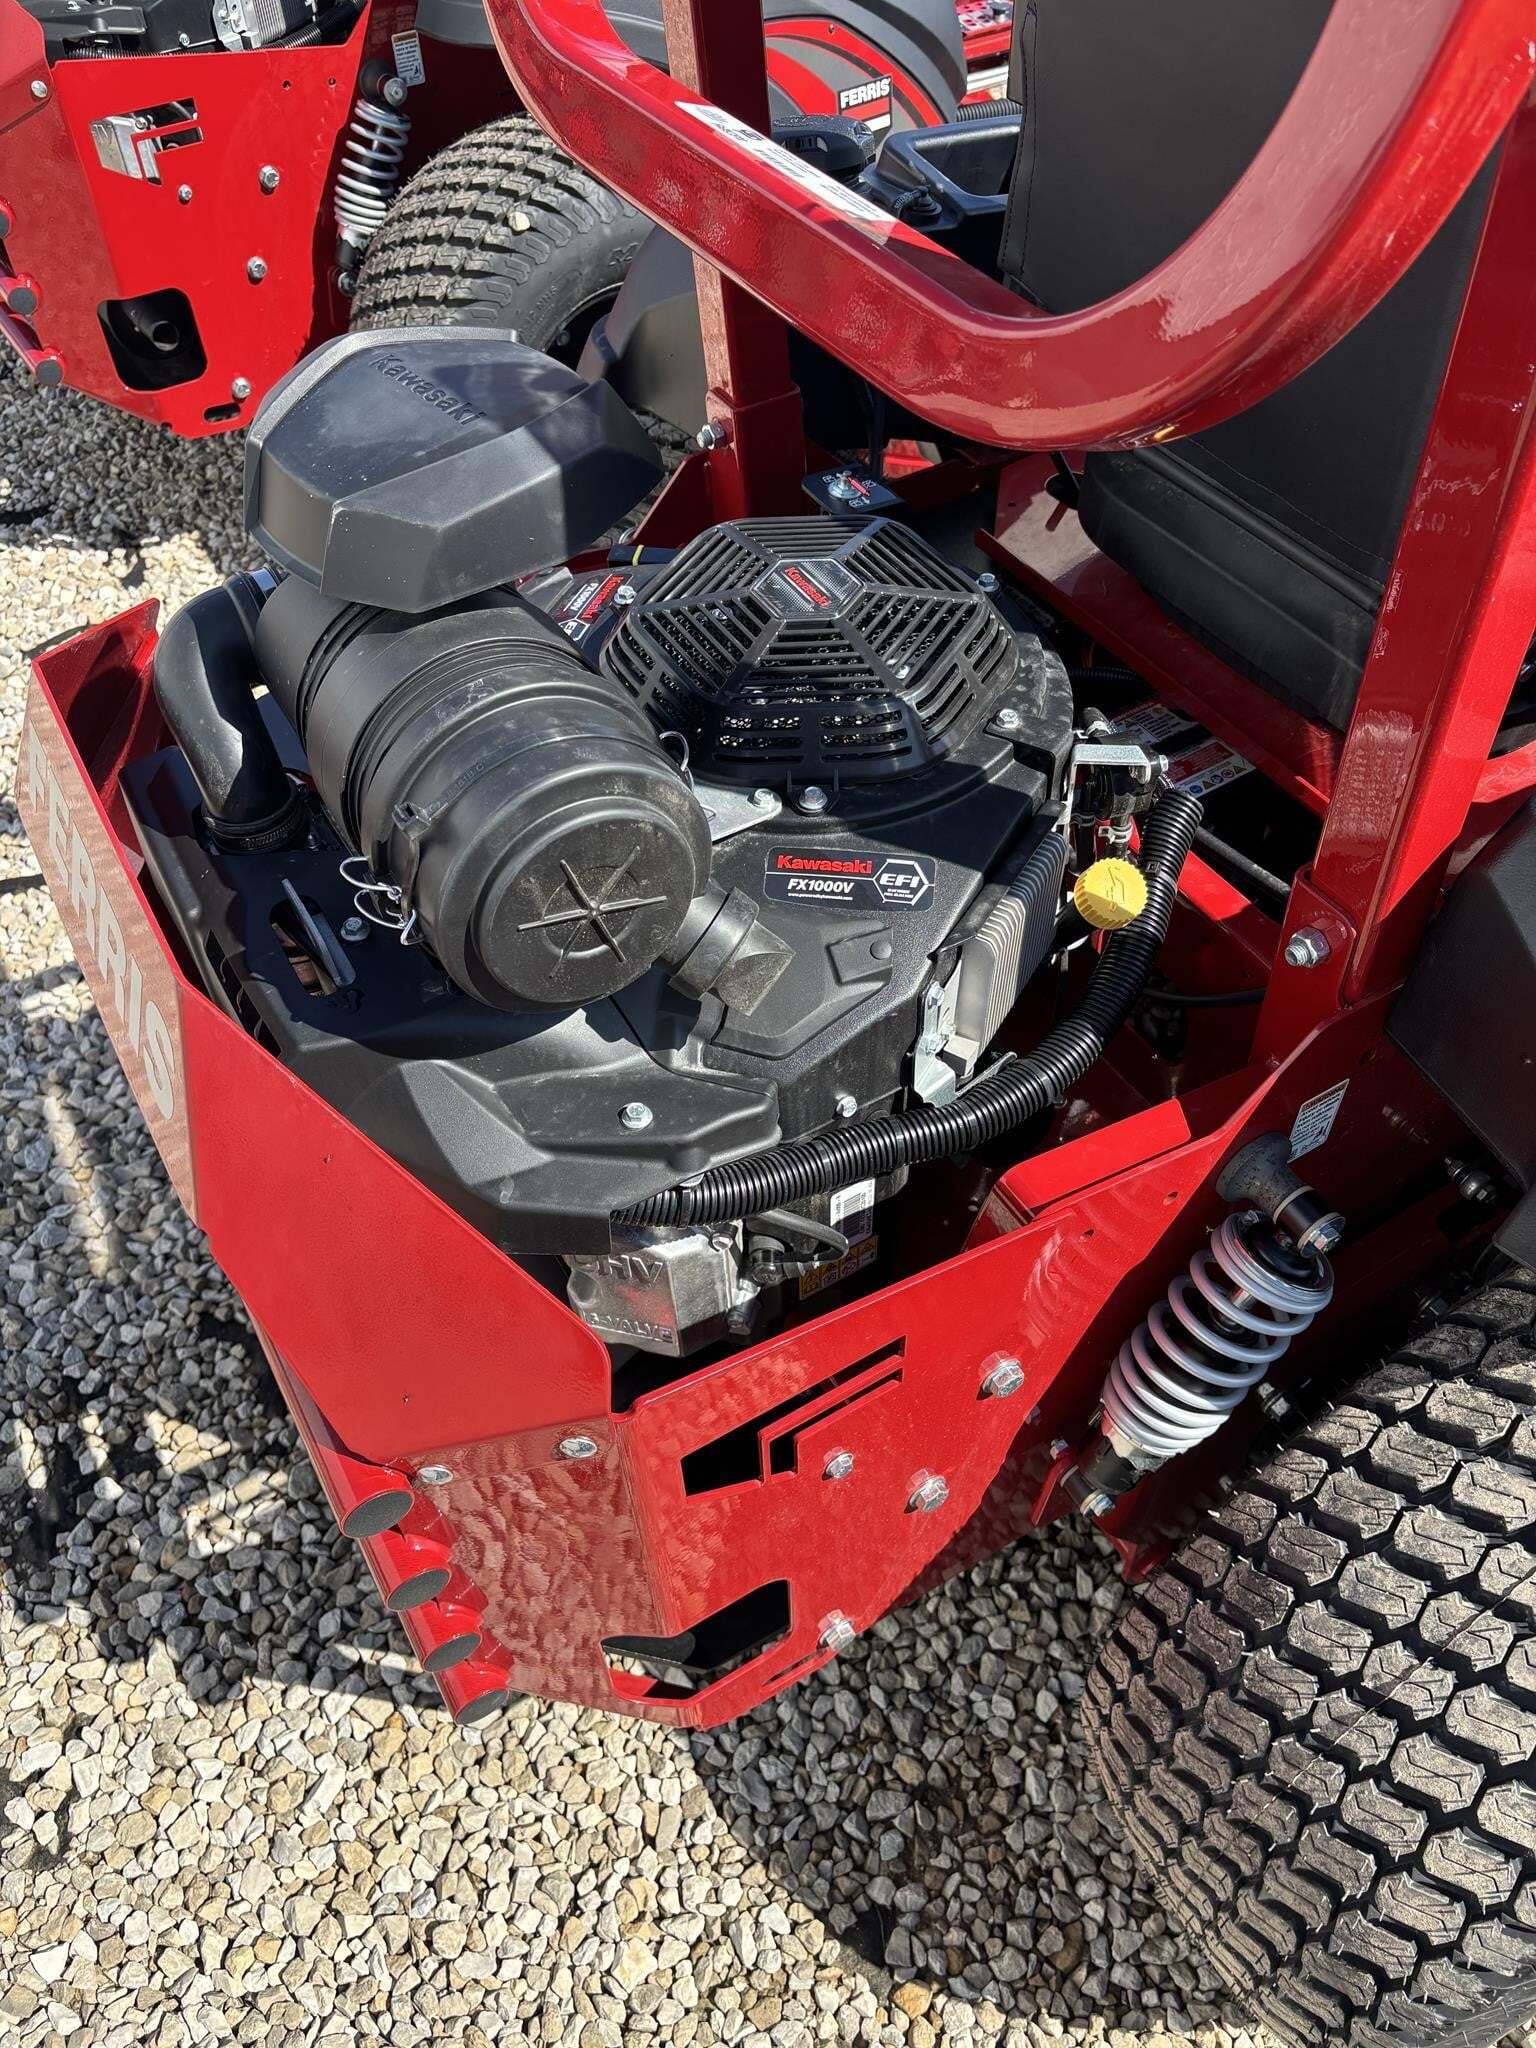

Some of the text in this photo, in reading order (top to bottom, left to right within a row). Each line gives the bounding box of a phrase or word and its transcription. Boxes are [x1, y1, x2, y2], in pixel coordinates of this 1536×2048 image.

[840, 78, 891, 109] FERRIS
[368, 354, 488, 425] Kawasaki
[581, 575, 625, 619] Kawasaki
[783, 566, 832, 609] Kawasaki
[776, 854, 873, 875] Kawasaki
[879, 873, 921, 889] EFI
[787, 878, 855, 894] FX1000V
[28, 720, 176, 1121] FERRIS
